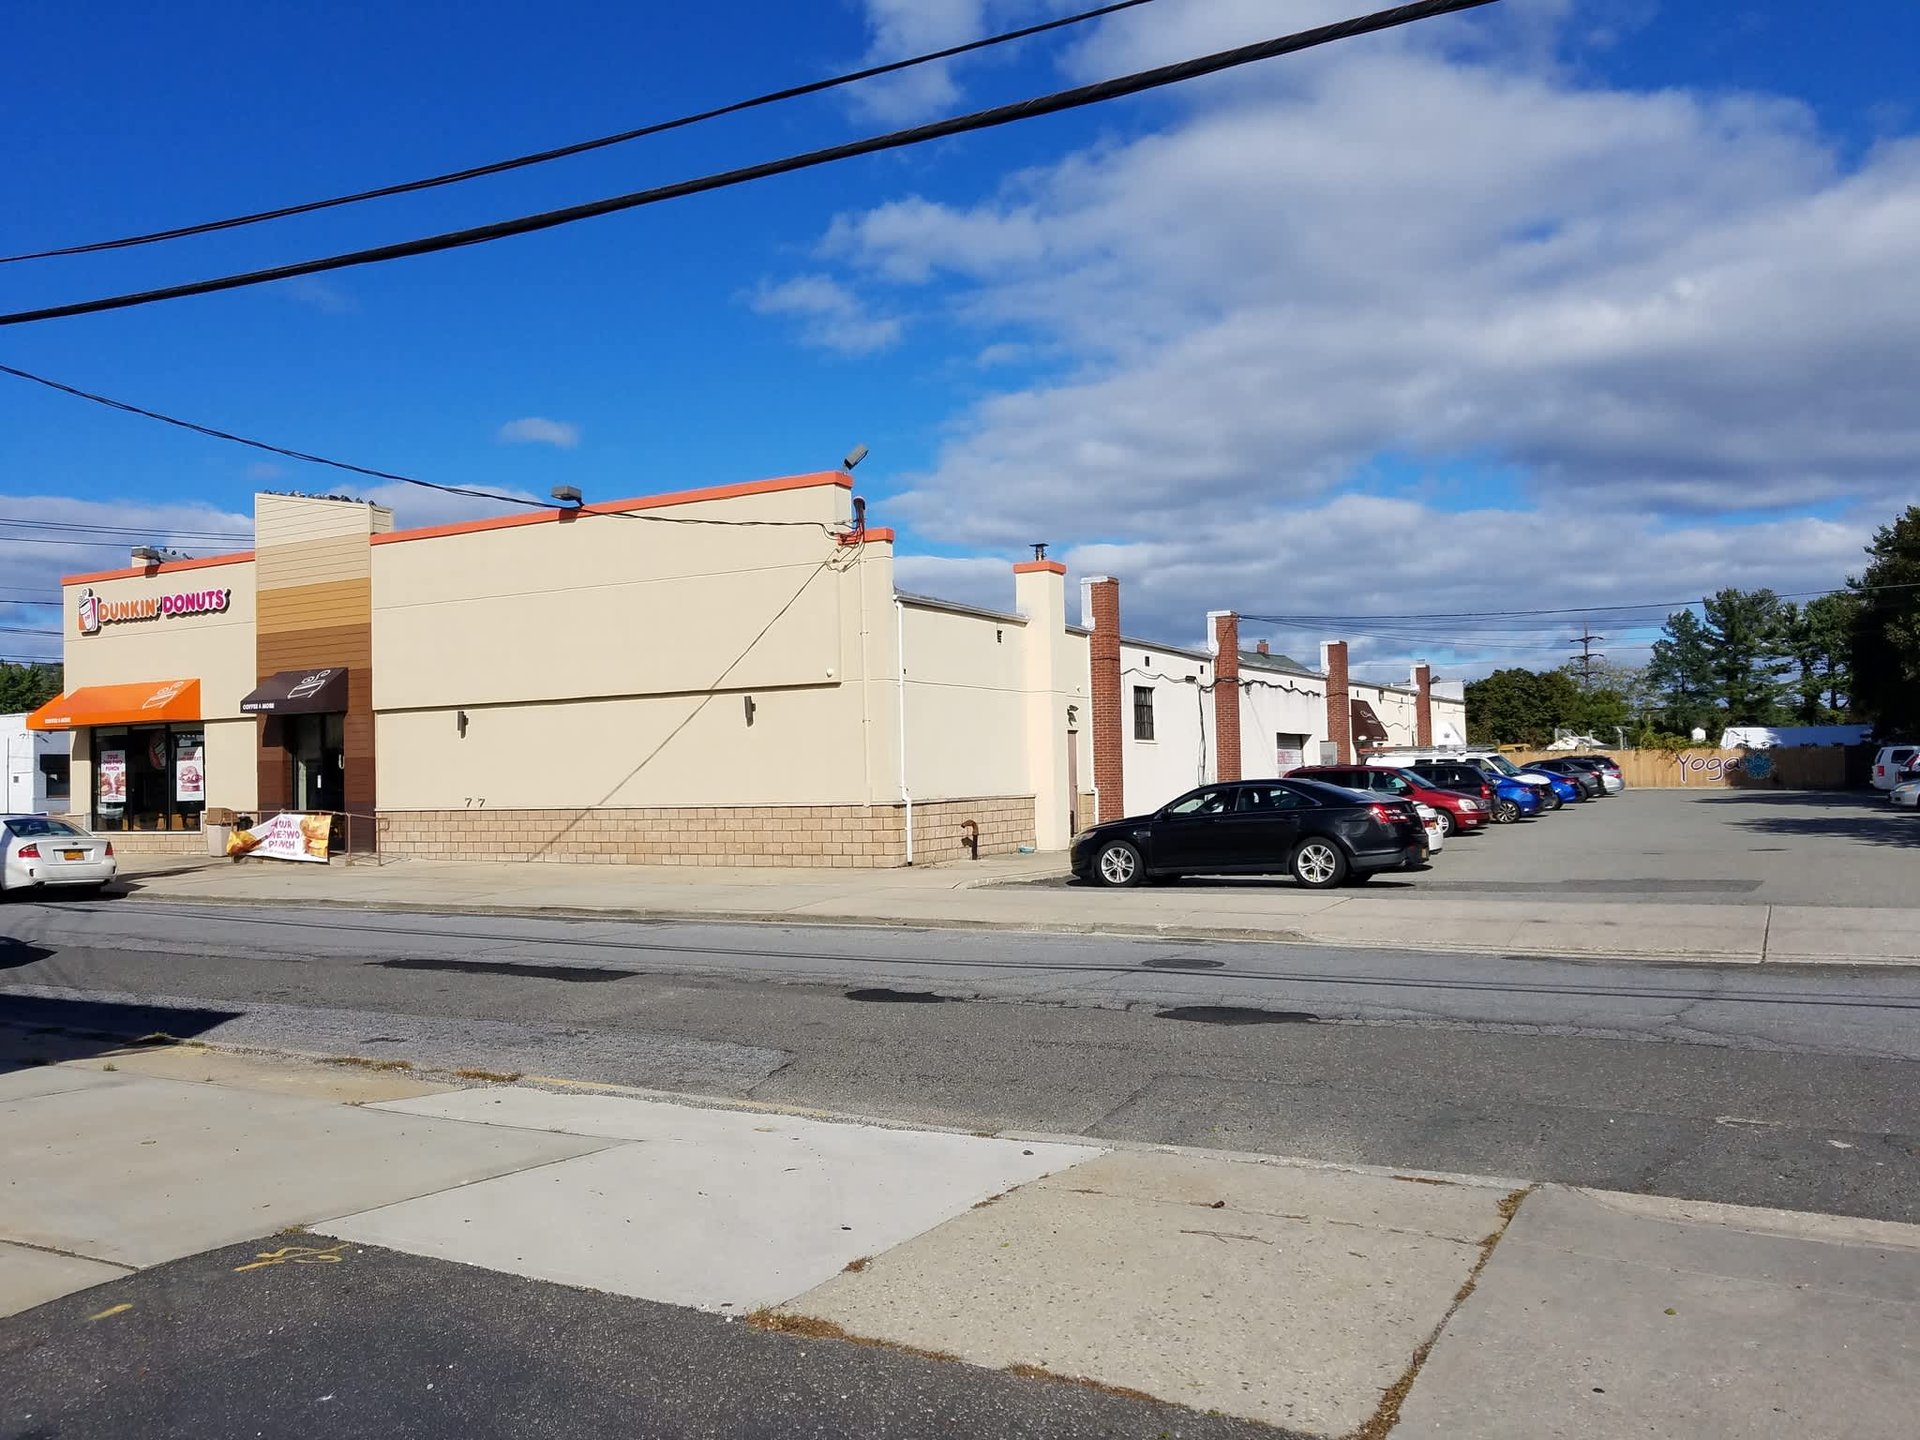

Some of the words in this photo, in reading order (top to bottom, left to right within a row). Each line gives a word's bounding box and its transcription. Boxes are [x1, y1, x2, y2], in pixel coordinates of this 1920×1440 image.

[162, 589, 225, 614] DONUTS
[242, 703, 259, 711] COFFEE
[1676, 753, 1742, 783] Yoga
